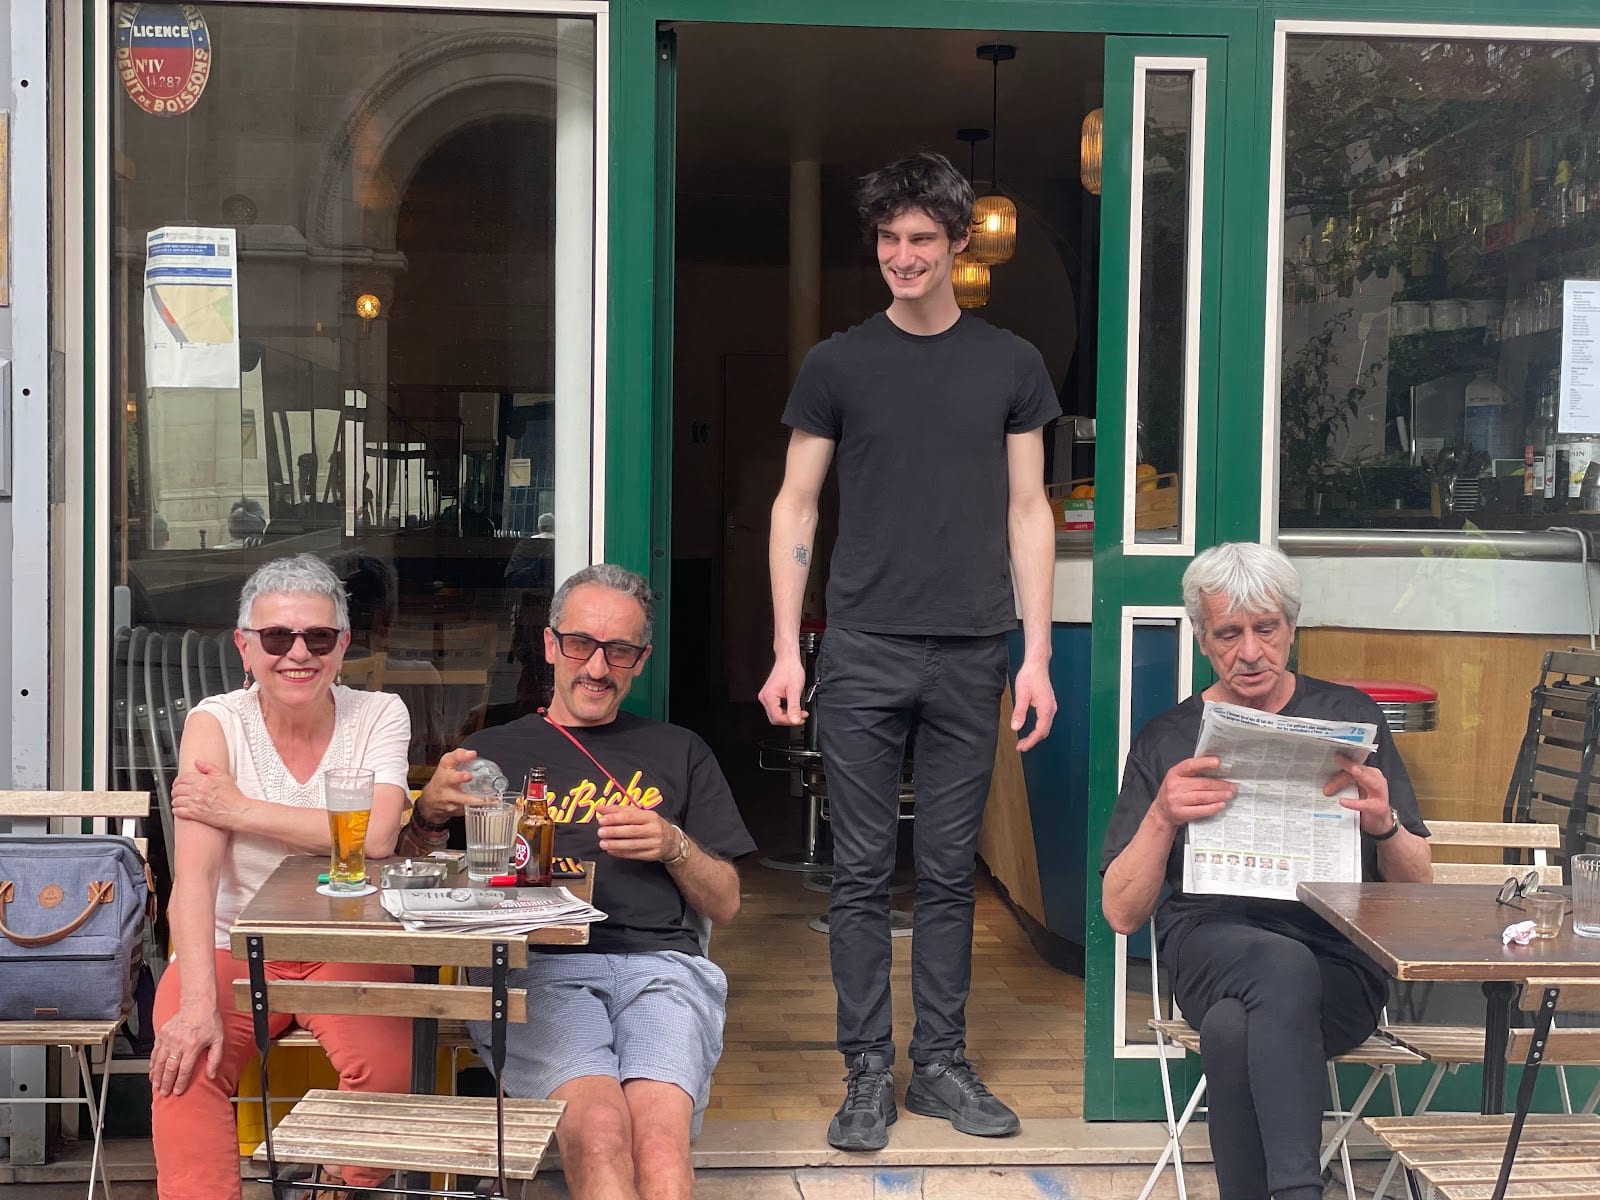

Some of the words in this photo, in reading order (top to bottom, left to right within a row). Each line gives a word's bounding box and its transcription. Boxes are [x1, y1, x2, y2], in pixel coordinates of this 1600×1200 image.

[181, 4, 203, 31] RIS
[133, 25, 190, 38] LICENCE
[118, 47, 144, 94] DEBIT
[138, 94, 151, 107] DE
[153, 48, 208, 112] BOISSONS
[1349, 726, 1366, 735] 75
